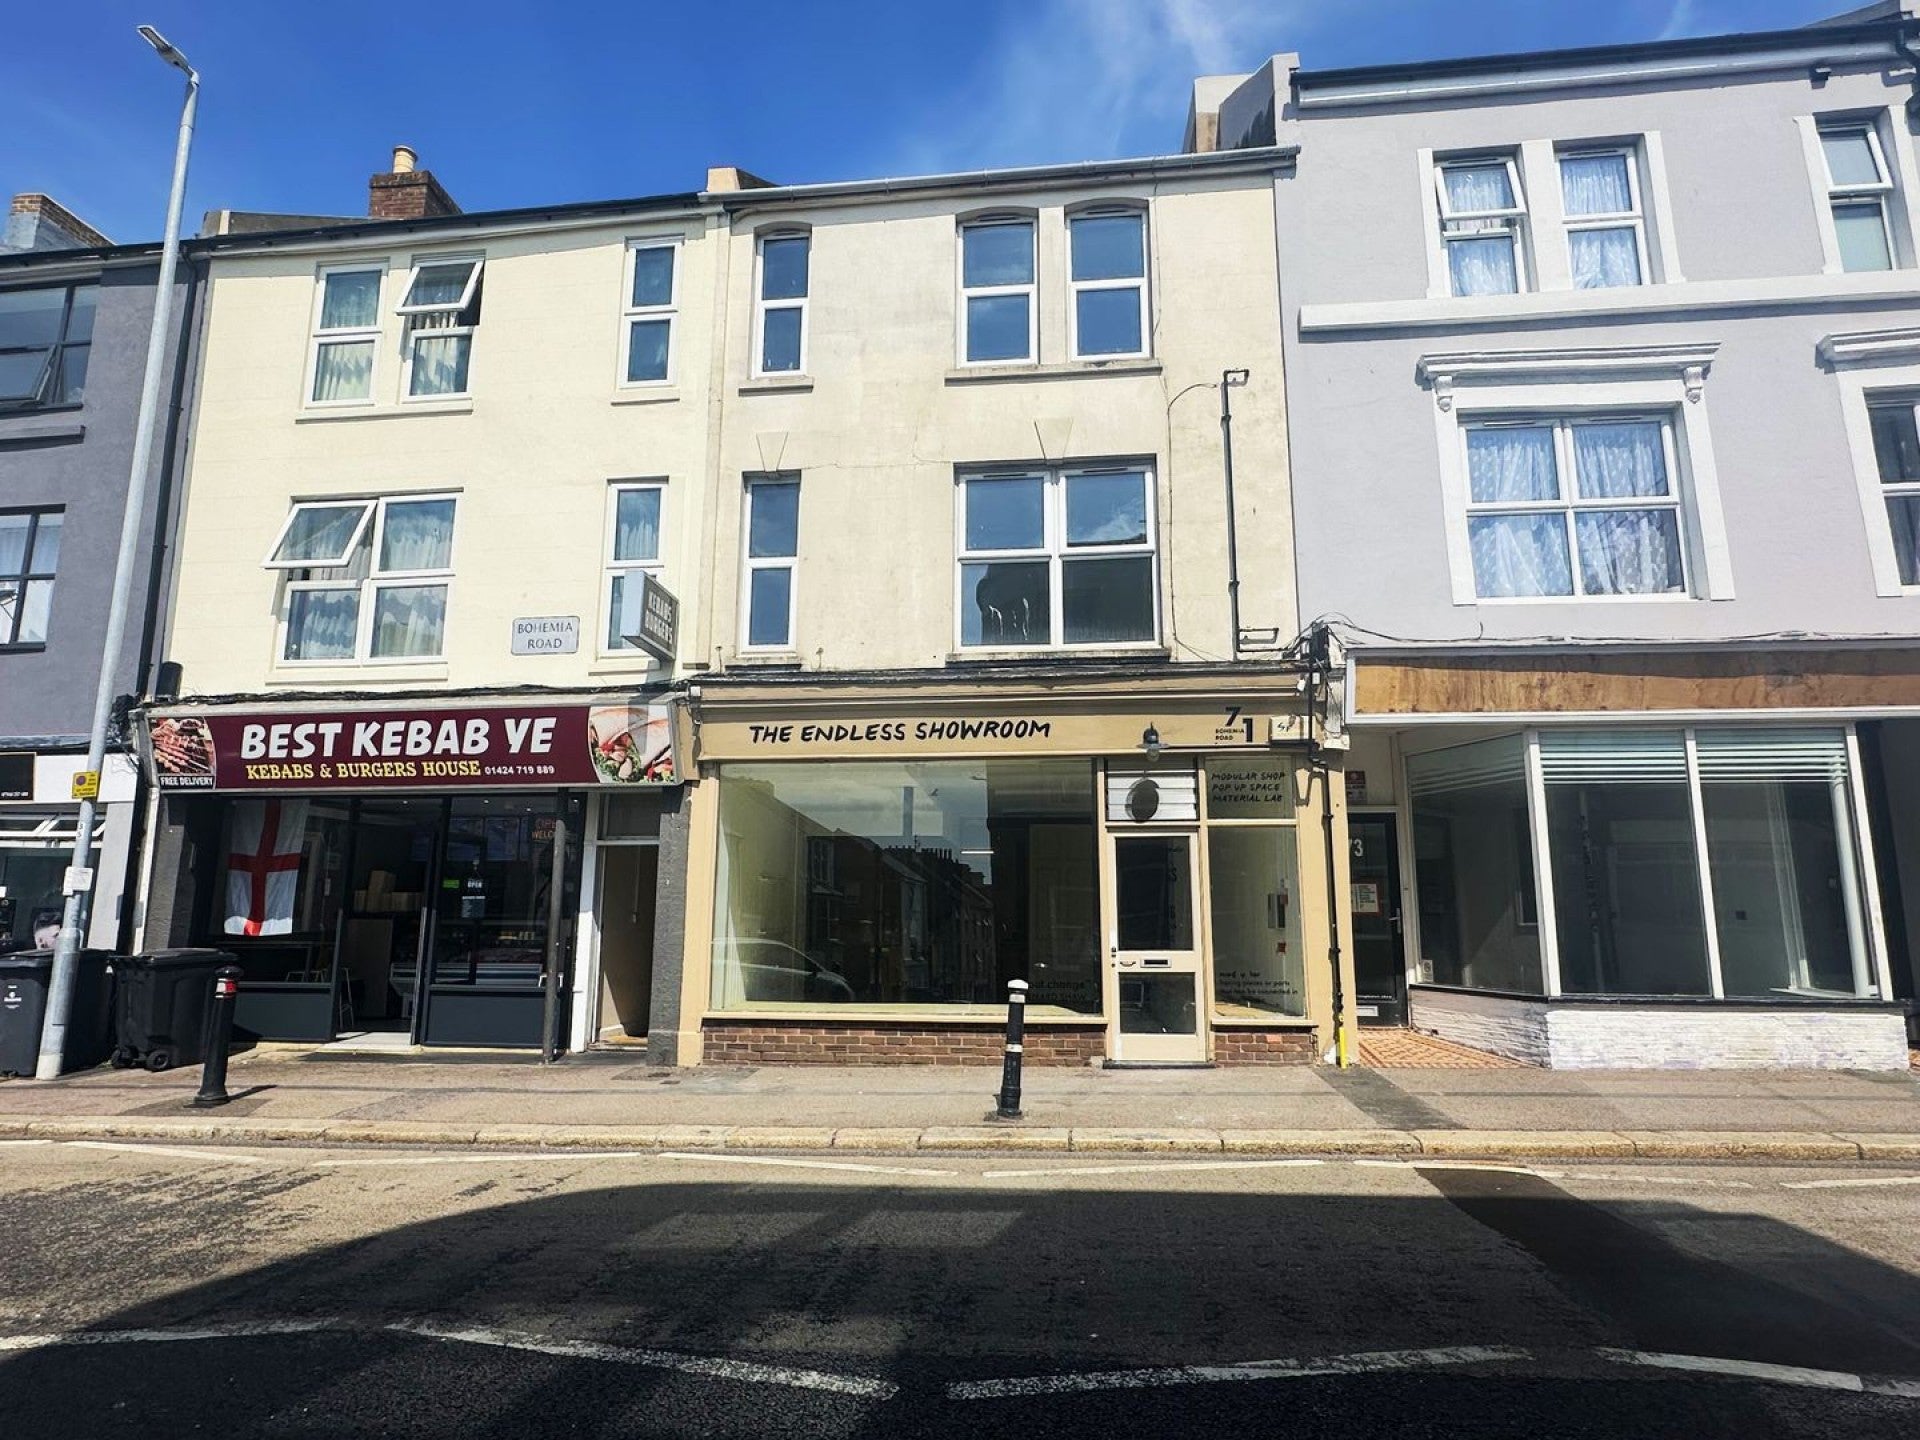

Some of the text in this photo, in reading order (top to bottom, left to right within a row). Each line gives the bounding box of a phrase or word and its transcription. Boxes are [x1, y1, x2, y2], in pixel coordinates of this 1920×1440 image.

[518, 622, 573, 634] BOHEMIA
[527, 638, 562, 649] ROAD
[749, 720, 1051, 744] THE ENDLESS SHOWROOM
[241, 722, 343, 759] BEST
[352, 718, 490, 757] KEBAB
[246, 760, 556, 780] KEBABS & BURGERS HOUSE 01424 719 889
[160, 776, 213, 786] FREE DELIVERY
[1212, 771, 1286, 781] MODULAR SHOP
[1212, 783, 1280, 792] POP UP SPACE
[1212, 794, 1284, 803] MATERIAL LAB
